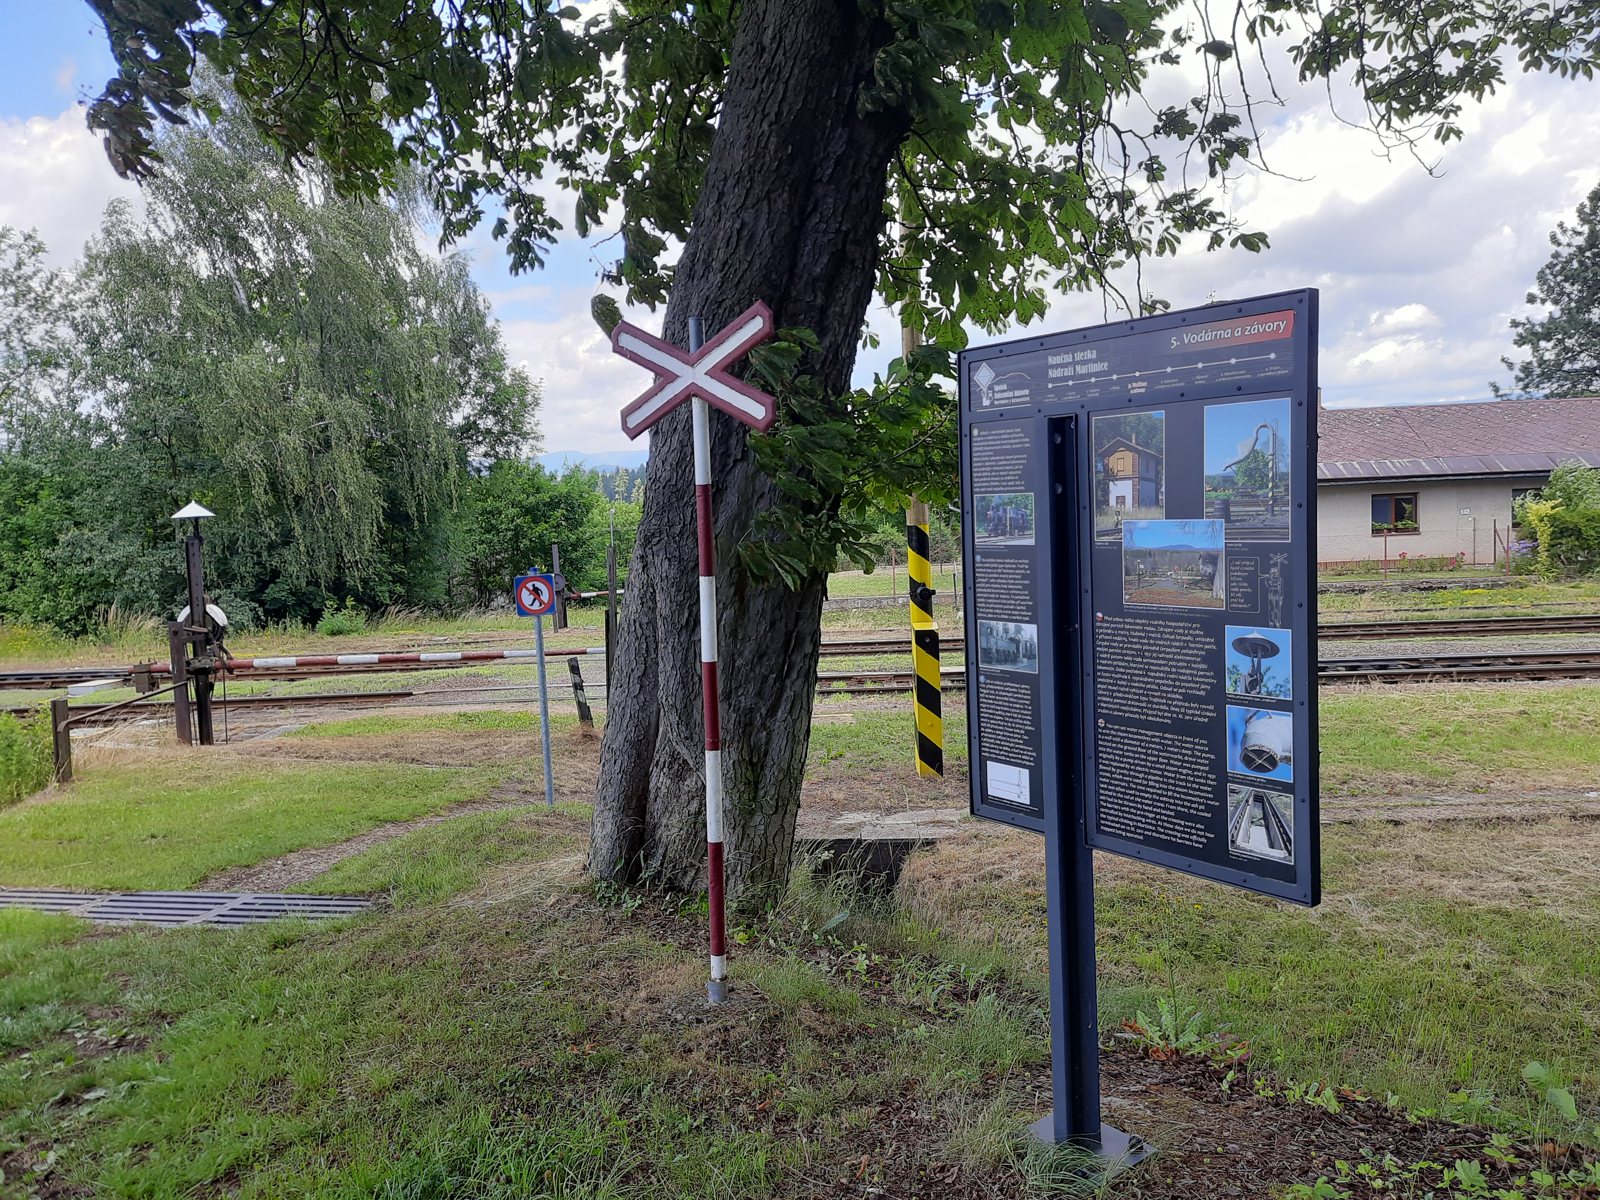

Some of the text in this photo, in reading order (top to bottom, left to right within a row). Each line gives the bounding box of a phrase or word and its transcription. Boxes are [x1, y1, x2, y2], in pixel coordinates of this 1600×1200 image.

[1170, 319, 1287, 349] 5. Vodárna a závory
[1074, 349, 1097, 362] stezka
[1075, 361, 1109, 376] Martinice
